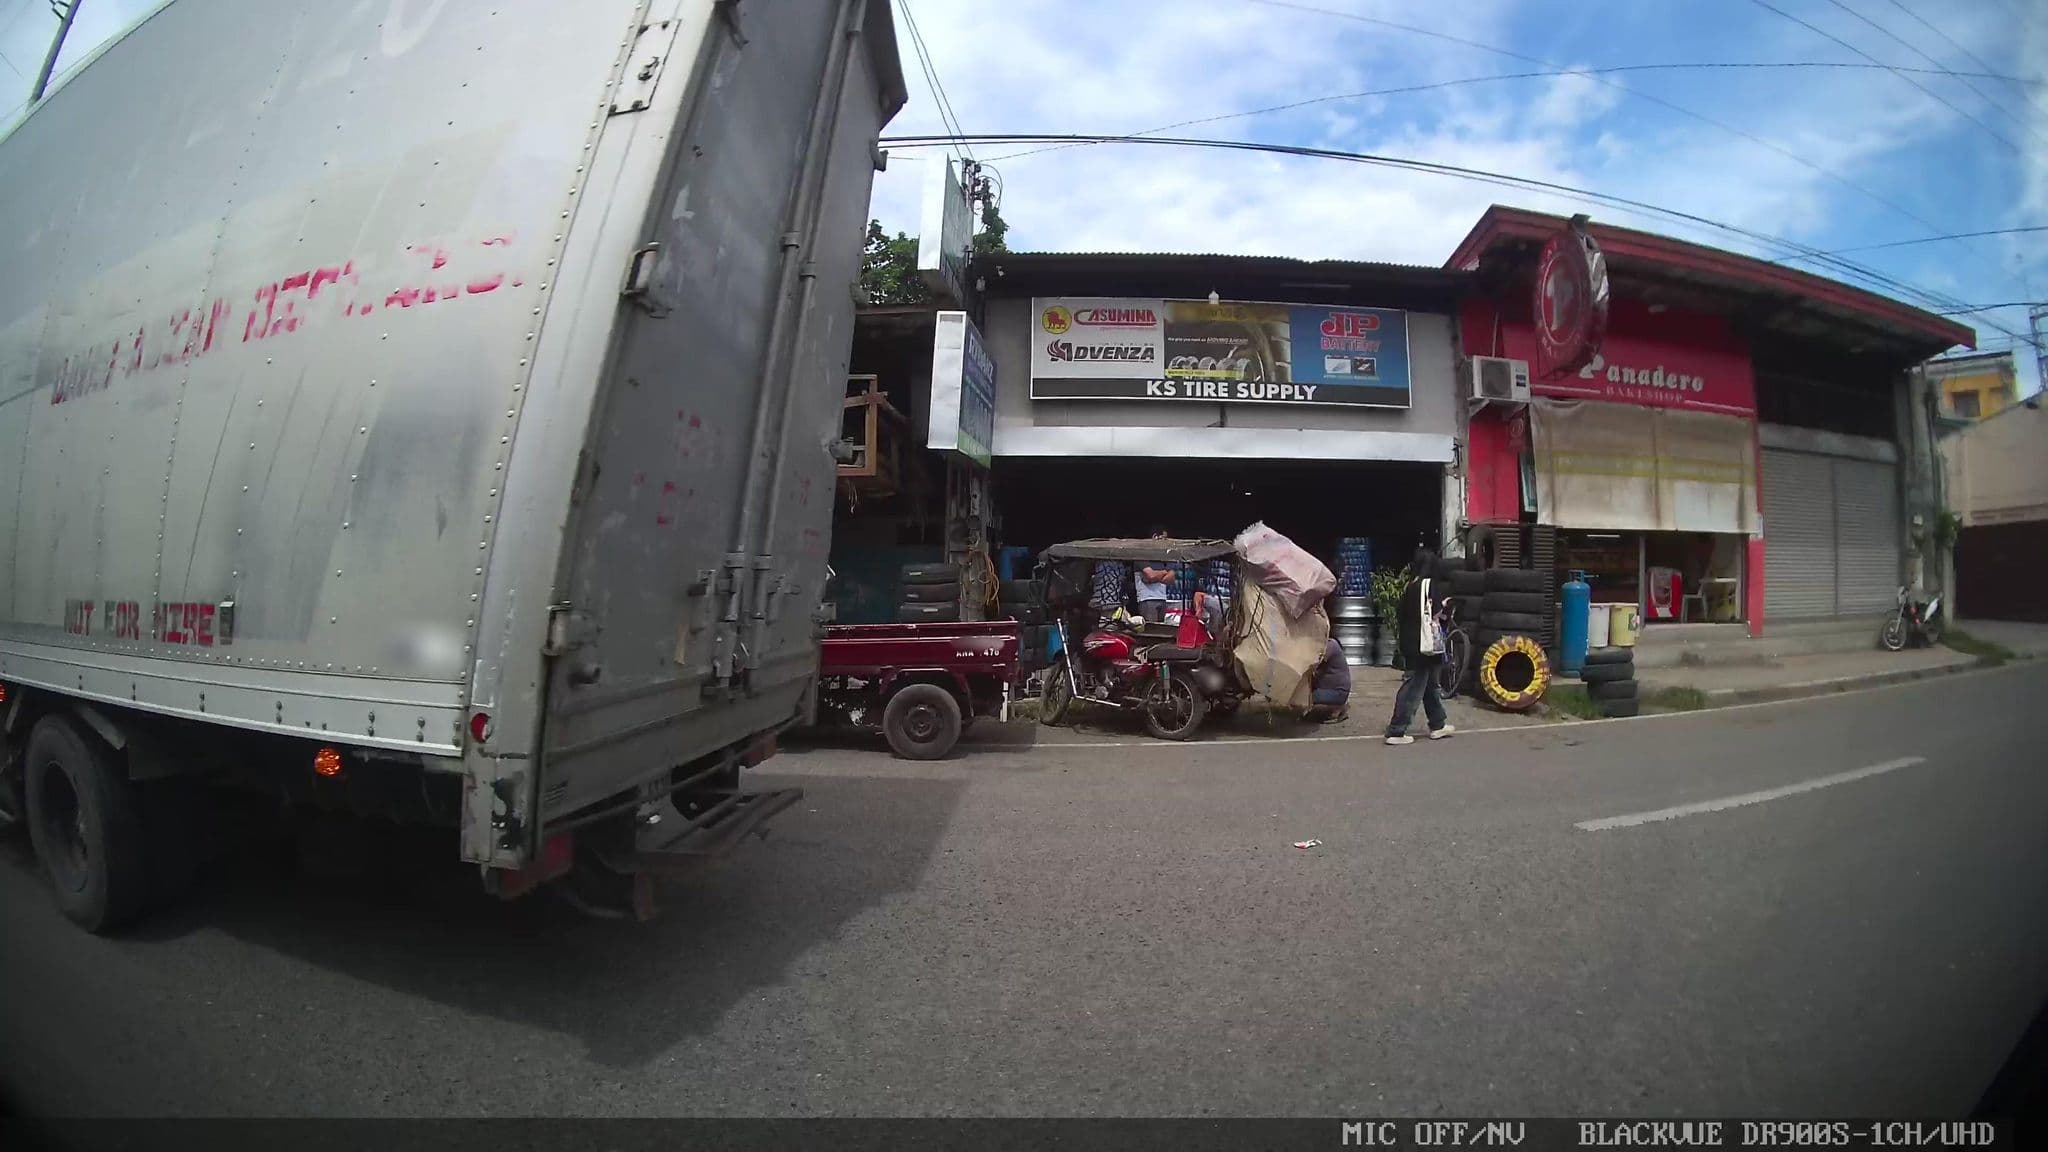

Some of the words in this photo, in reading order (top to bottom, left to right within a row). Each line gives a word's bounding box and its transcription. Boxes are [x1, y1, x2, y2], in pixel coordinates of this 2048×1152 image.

[1074, 306, 1157, 327] CASUMINA
[1320, 309, 1381, 339] JP
[1047, 339, 1155, 363] ADVENZA
[1146, 380, 1177, 397] KS
[1183, 381, 1229, 398] TIRE
[1236, 382, 1317, 401] SUPPLY
[104, 600, 140, 640] FOR
